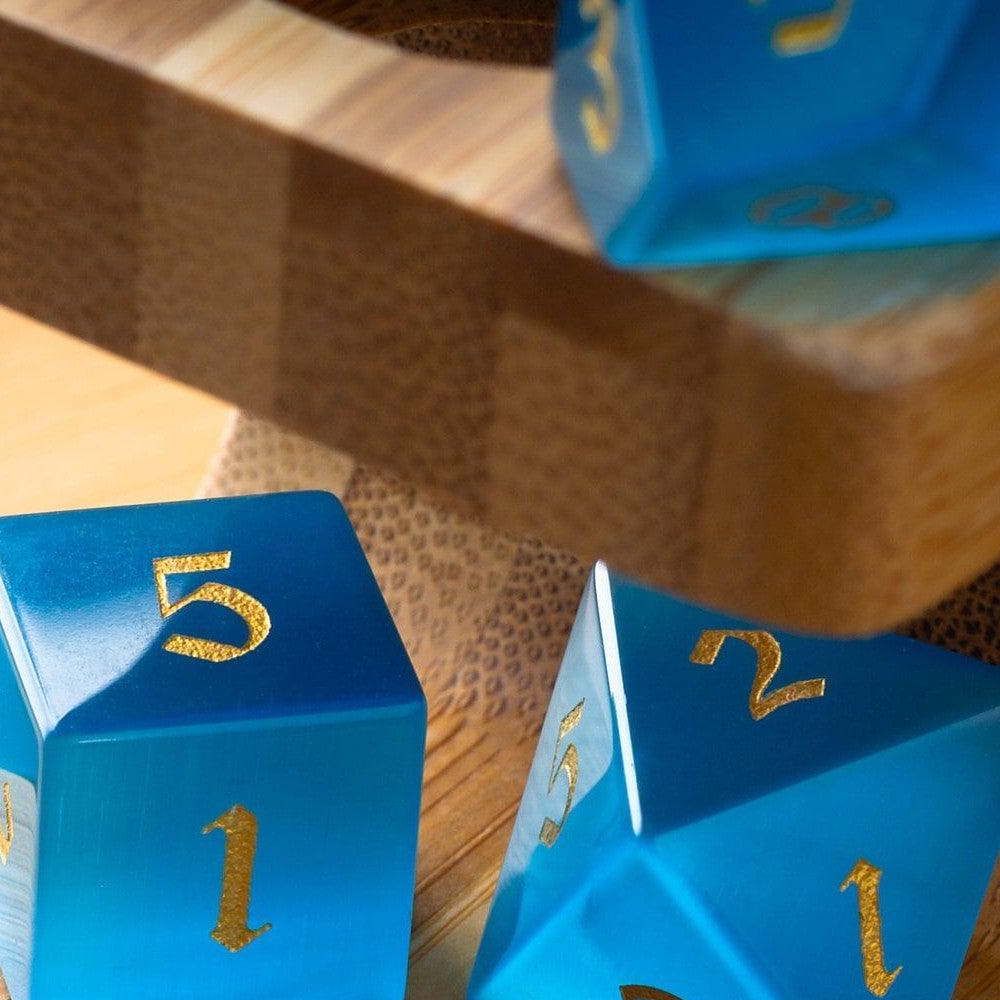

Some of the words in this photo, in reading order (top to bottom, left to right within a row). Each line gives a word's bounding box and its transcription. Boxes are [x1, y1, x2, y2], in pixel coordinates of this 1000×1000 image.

[152, 550, 272, 663] 5
[689, 630, 826, 721] 2
[201, 804, 273, 953] 1
[839, 858, 903, 998] 1
